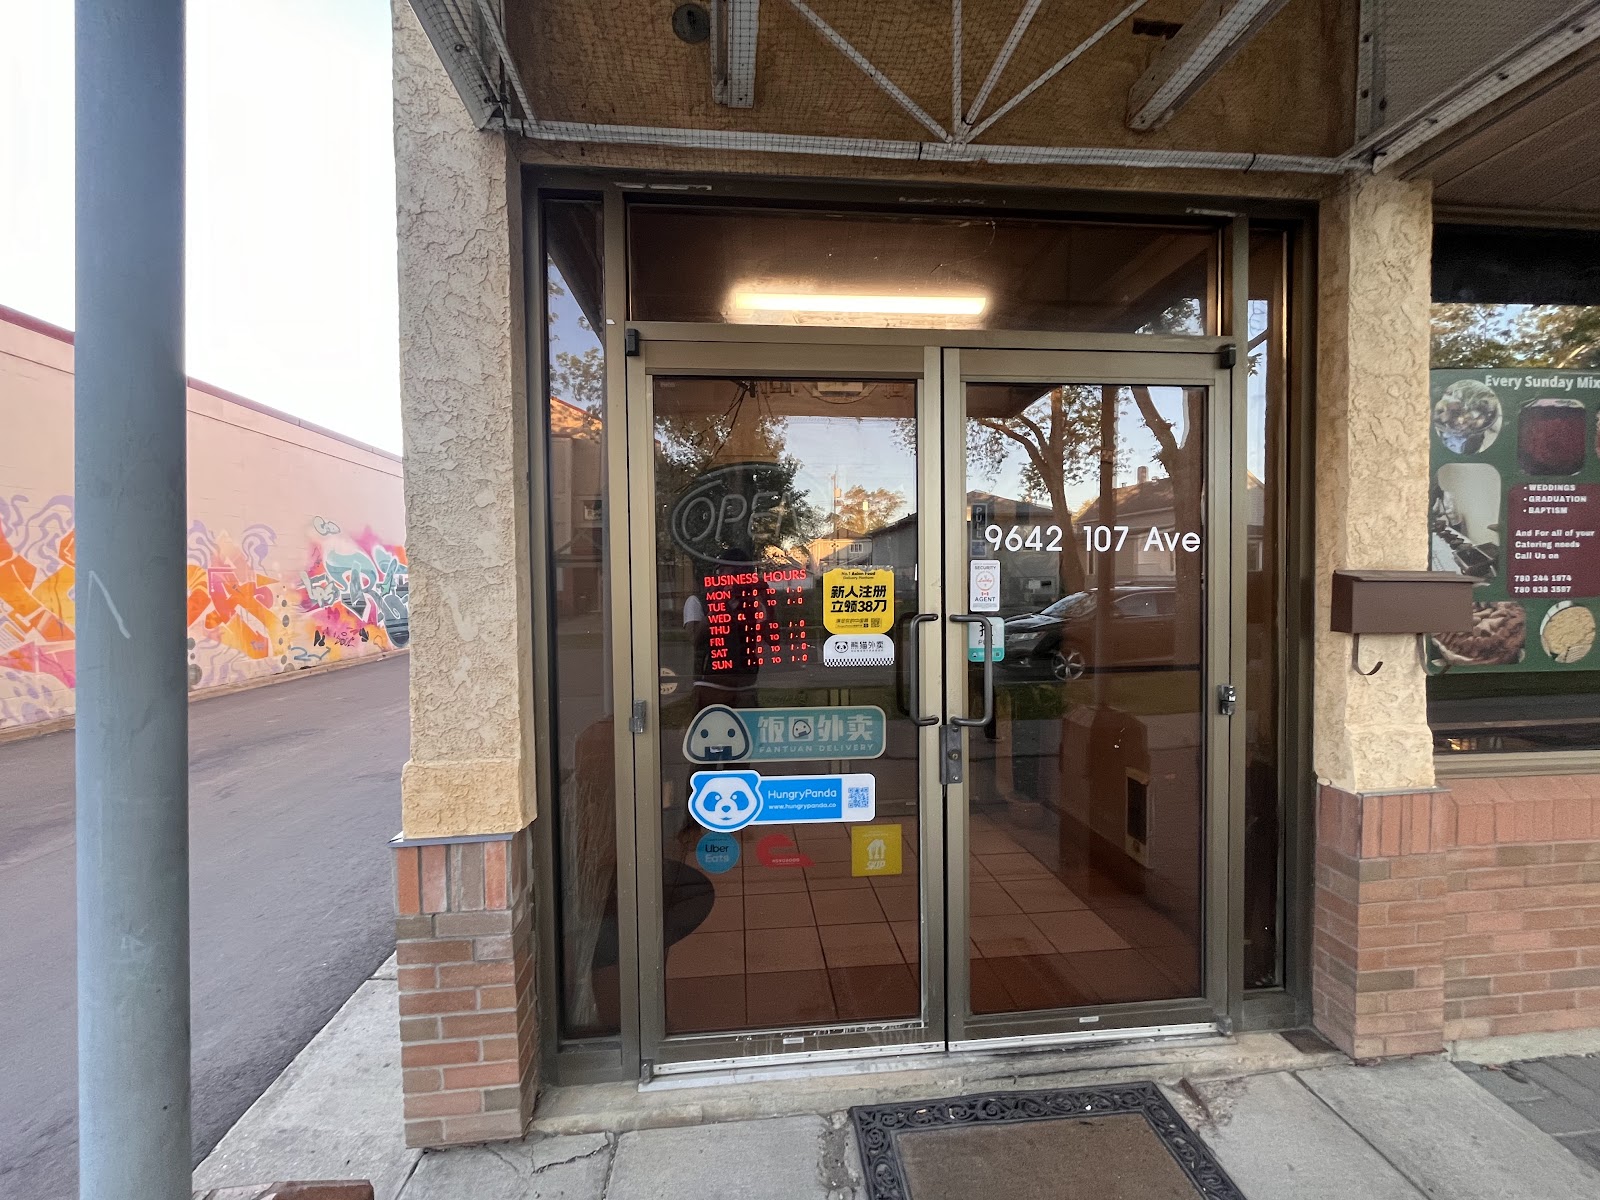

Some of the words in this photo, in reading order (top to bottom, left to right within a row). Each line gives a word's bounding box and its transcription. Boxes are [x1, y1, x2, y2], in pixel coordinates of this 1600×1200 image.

[1485, 375, 1522, 390] Every
[1525, 375, 1574, 391] Sunday
[1551, 529, 1562, 537] all
[1564, 529, 1574, 537] of
[984, 524, 1063, 552] 9642
[1083, 525, 1129, 552] 107
[1143, 526, 1201, 552] Ave
[1515, 541, 1552, 549] Catering
[704, 573, 759, 587] BUSINESS
[763, 569, 807, 582] HOURS
[706, 591, 731, 600] MON
[830, 585, 887, 598] 新人注册
[708, 603, 726, 612] TUE
[830, 600, 887, 613] 立领38刀
[708, 614, 731, 623] WED
[709, 626, 730, 635] THU
[710, 638, 724, 647] FRI
[711, 649, 728, 659] SAT
[712, 660, 733, 670] SUN
[759, 745, 813, 753] FANTUAN
[767, 788, 837, 800] HungryPanda
[705, 844, 729, 853] Uber
[705, 854, 729, 863] Eats
